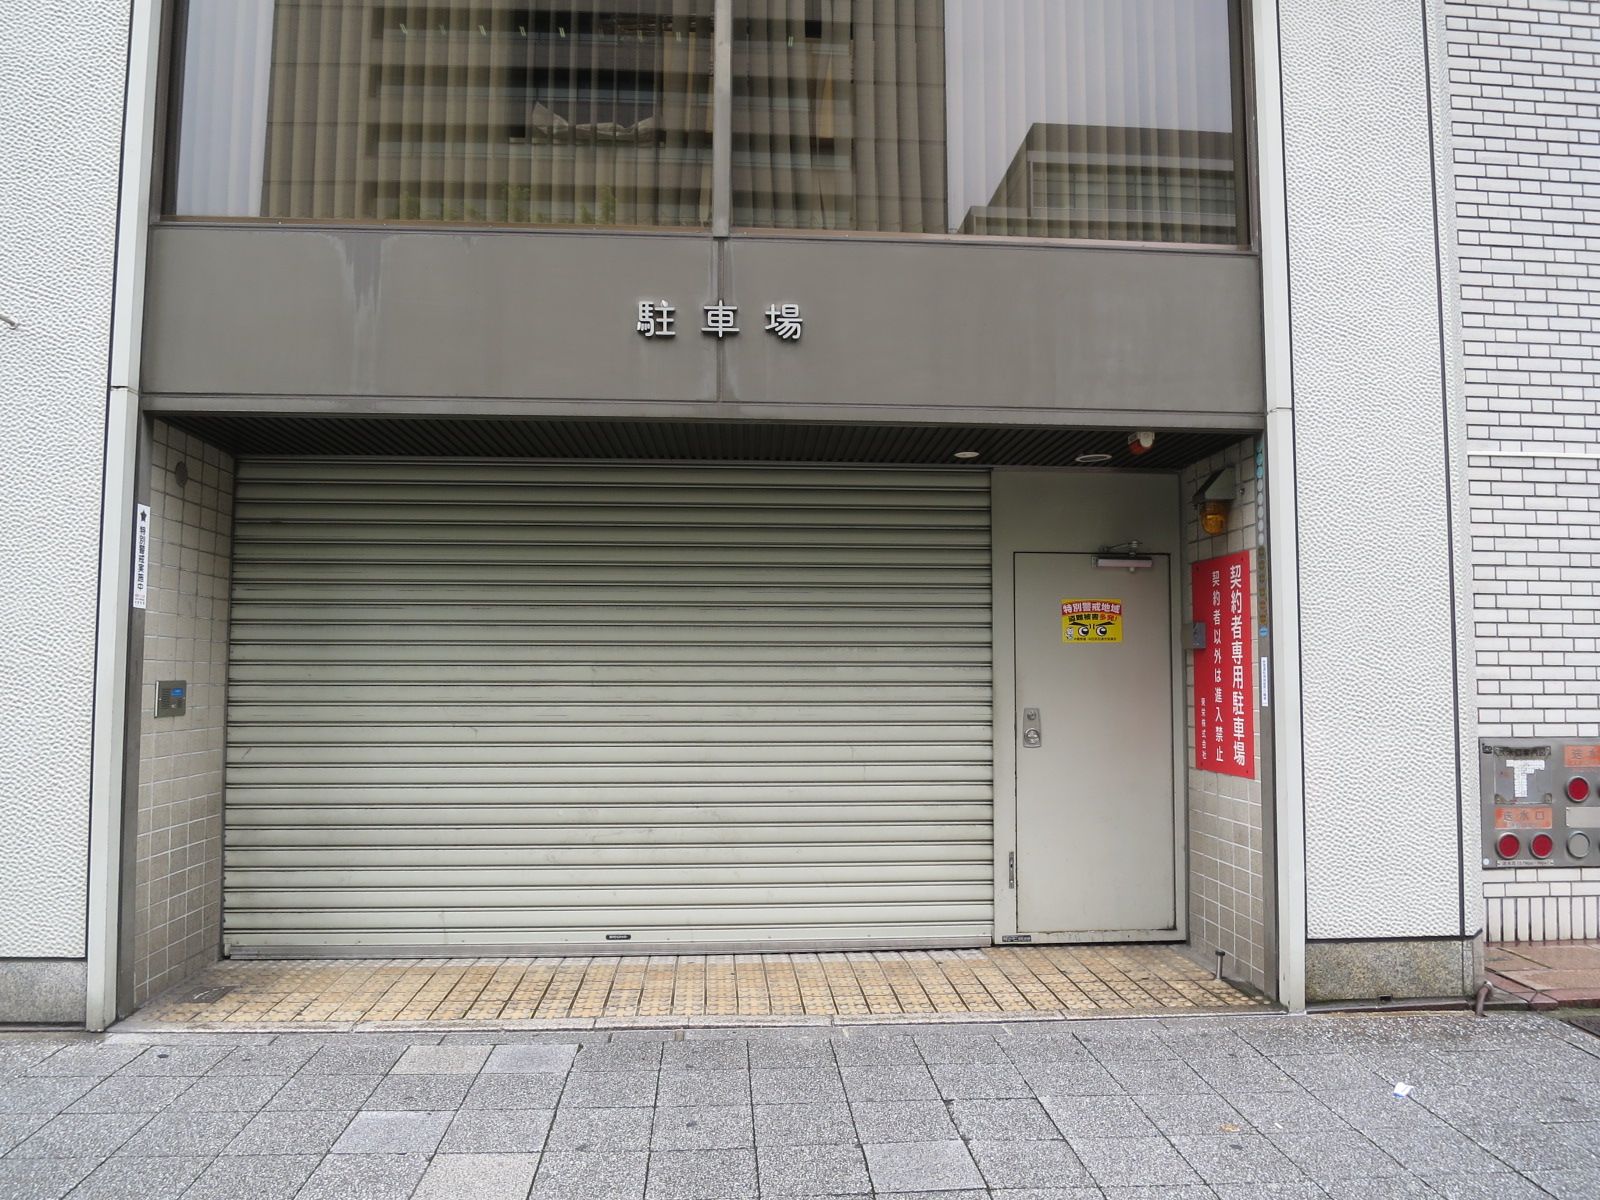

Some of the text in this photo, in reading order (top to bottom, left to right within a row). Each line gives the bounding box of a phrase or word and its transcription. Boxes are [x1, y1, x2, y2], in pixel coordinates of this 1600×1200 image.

[636, 299, 803, 340] 駐車場
[1062, 602, 1121, 614] 特別警戒地域
[1211, 570, 1223, 762] 契約者以外は進入禁止
[1230, 565, 1245, 766] 契約者専用駐車場
